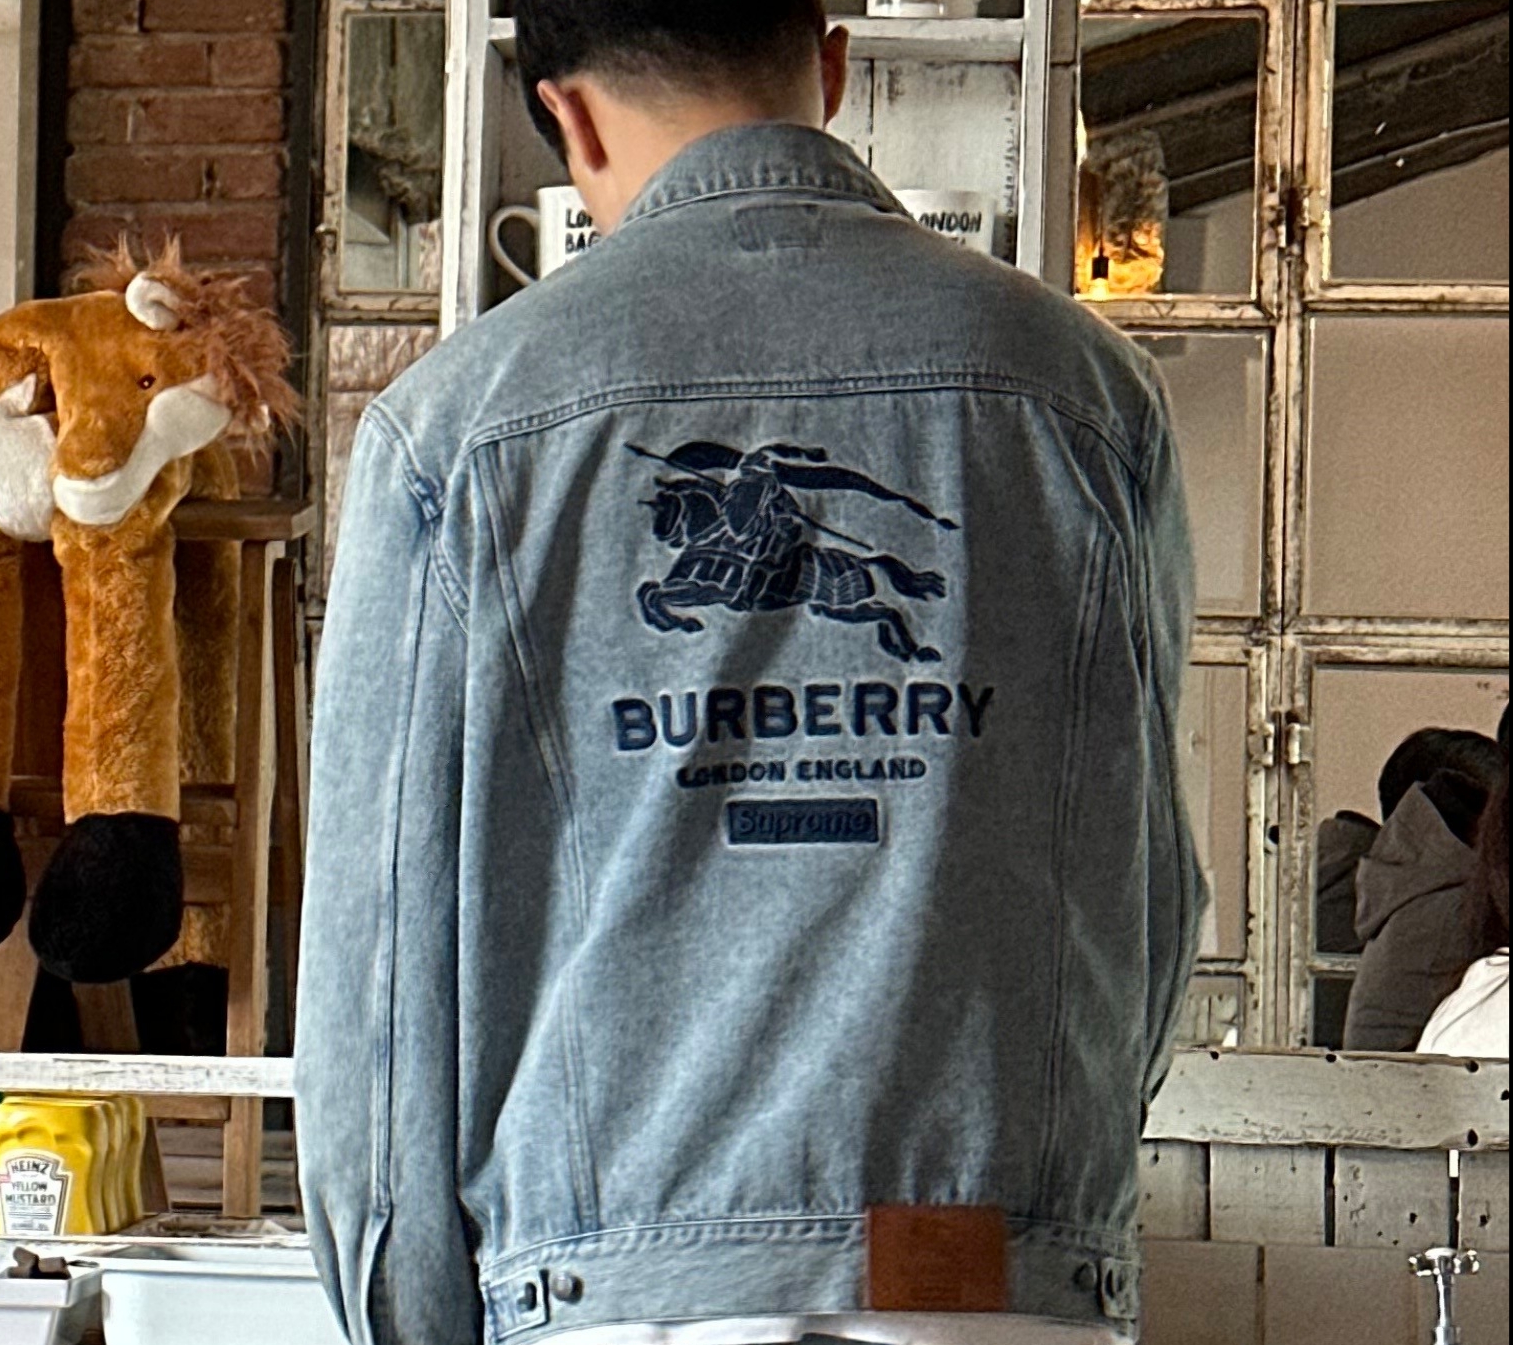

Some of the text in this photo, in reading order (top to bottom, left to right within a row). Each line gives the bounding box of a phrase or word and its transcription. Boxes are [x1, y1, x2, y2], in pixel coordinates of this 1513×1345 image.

[918, 210, 982, 233] ONDON
[612, 682, 994, 751] BURBERRY
[676, 758, 927, 788] LONDON ENGLAND
[11, 1159, 49, 1175] HEINZ
[5, 1193, 56, 1206] MUSTARD
